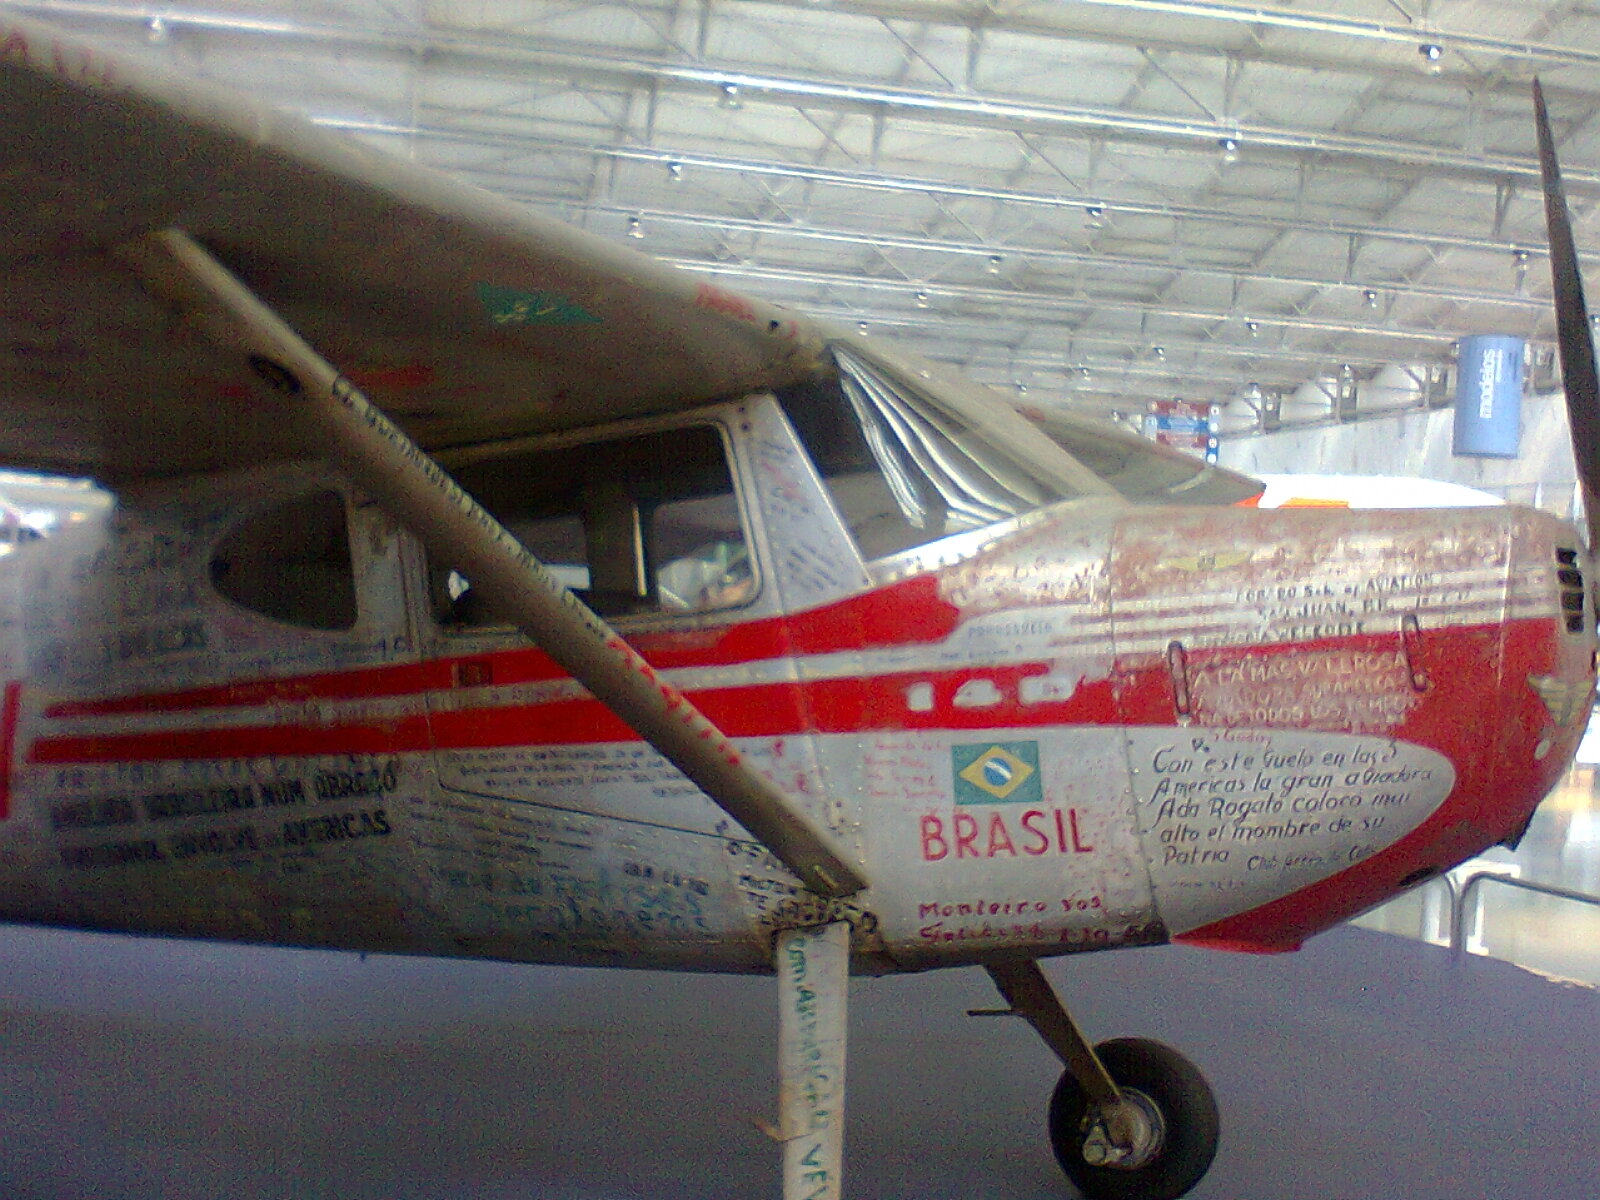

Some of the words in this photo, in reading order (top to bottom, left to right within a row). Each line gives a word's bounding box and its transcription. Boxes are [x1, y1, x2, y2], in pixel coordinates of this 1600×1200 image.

[1153, 745, 1193, 773] Con
[1323, 752, 1346, 769] en
[1353, 744, 1377, 768] las
[1254, 771, 1272, 793] la
[1280, 775, 1334, 798] gran
[1152, 797, 1200, 829] Ada
[1208, 792, 1284, 826] Rogato
[919, 807, 1094, 862] BRASIL
[1160, 824, 1200, 843] alto
[1207, 825, 1226, 841] el
[1329, 816, 1353, 833] de
[1164, 845, 1230, 867] Patria
